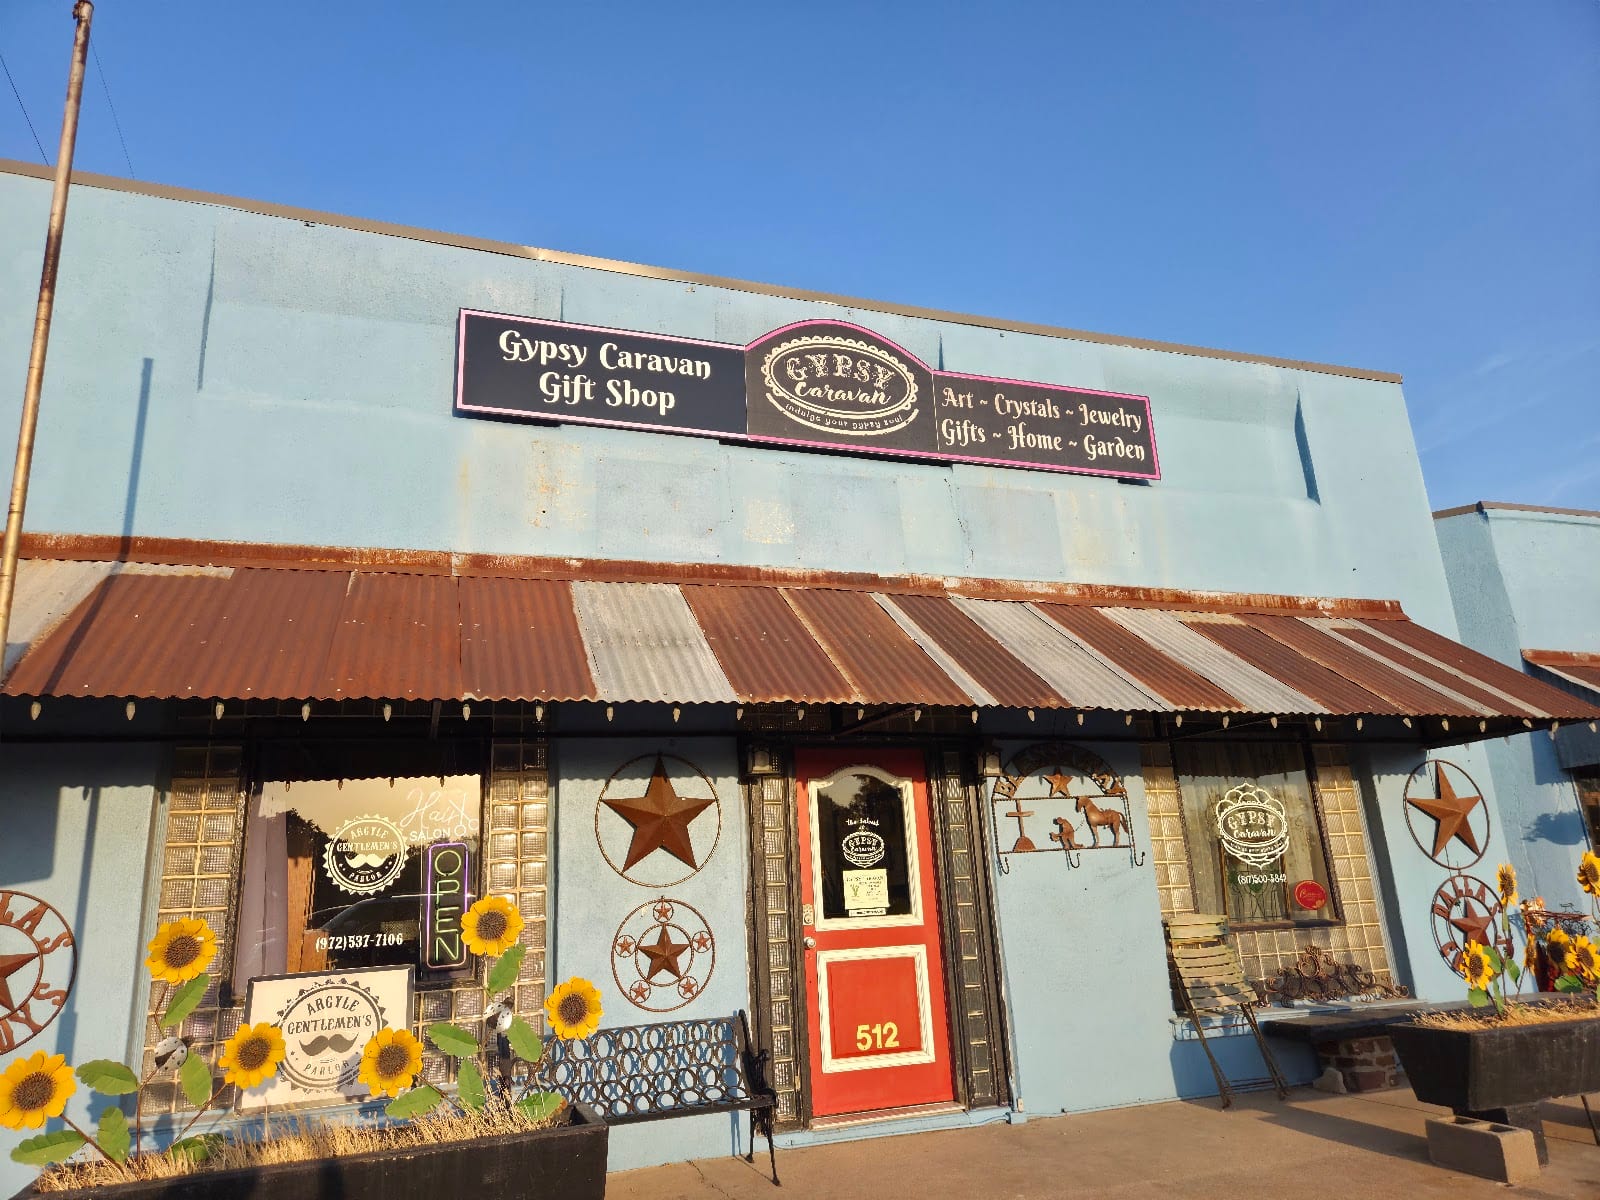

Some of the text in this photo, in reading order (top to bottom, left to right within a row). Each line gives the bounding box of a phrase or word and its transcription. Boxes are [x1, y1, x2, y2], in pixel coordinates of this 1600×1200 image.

[499, 330, 711, 380] Gypsy Caravan
[785, 353, 895, 392] GYPSY
[539, 371, 675, 416] Gift Shop
[795, 381, 891, 405] Caravan
[941, 387, 974, 409] Art
[994, 393, 1060, 419] Crystals
[1078, 403, 1142, 432] Jewelry
[825, 417, 848, 427] your
[852, 421, 881, 430] gypsy
[883, 414, 903, 426] soul
[941, 418, 986, 446] Gifts
[1007, 421, 1063, 450] Home
[1083, 434, 1145, 461] Garden
[1227, 810, 1276, 830] GYPSY
[350, 826, 389, 840] ARGYLE
[409, 828, 451, 842] SALON
[1233, 828, 1276, 838] Caravan
[336, 841, 398, 852] GENTLEMEN'S
[349, 870, 383, 883] PARLOR
[434, 850, 462, 961] OPEN
[315, 933, 404, 952] (972)537-7106
[306, 995, 360, 1016] ARGYLE
[287, 1014, 372, 1035] GENTLEMEN'S
[856, 1021, 900, 1051] 512
[303, 1060, 350, 1076] PARLOR
